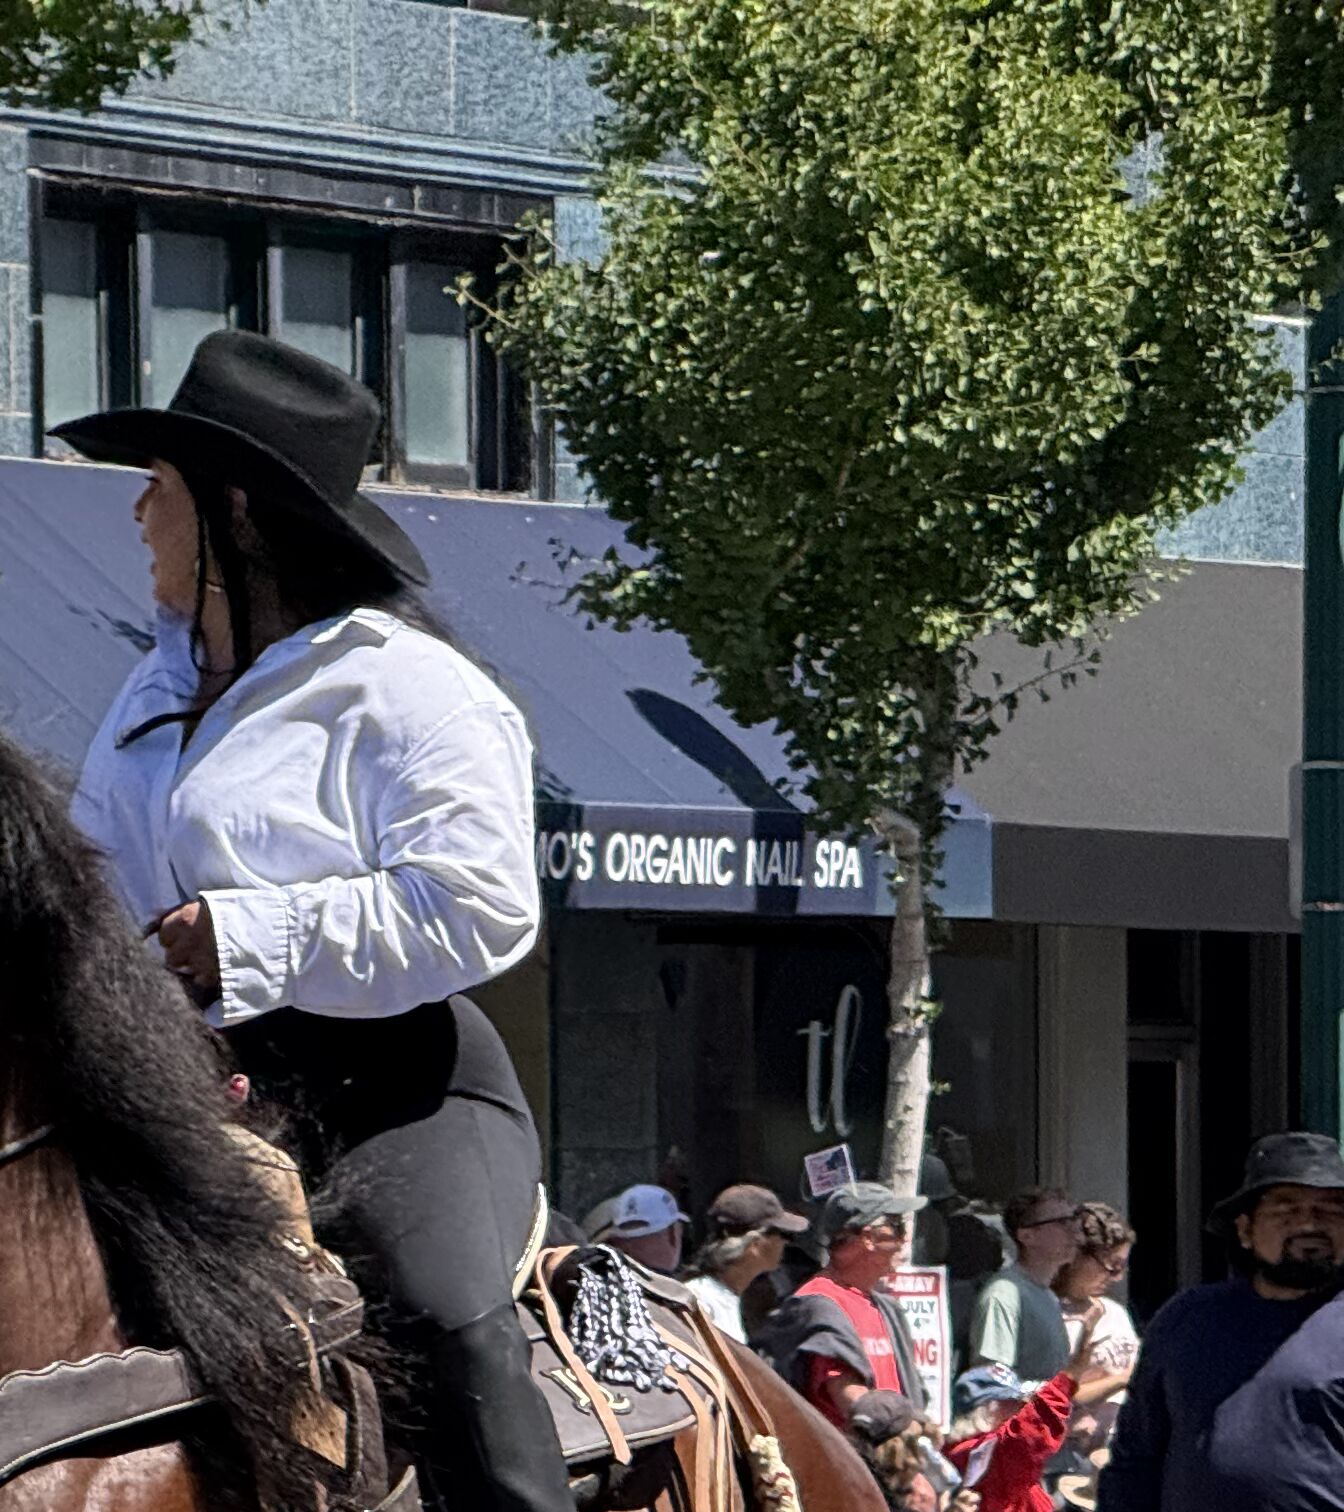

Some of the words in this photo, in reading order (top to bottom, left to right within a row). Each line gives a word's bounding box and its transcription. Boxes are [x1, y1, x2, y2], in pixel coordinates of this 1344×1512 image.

[605, 832, 736, 887] ORGANIC
[745, 839, 805, 887] NAIL
[814, 838, 862, 889] SPA
